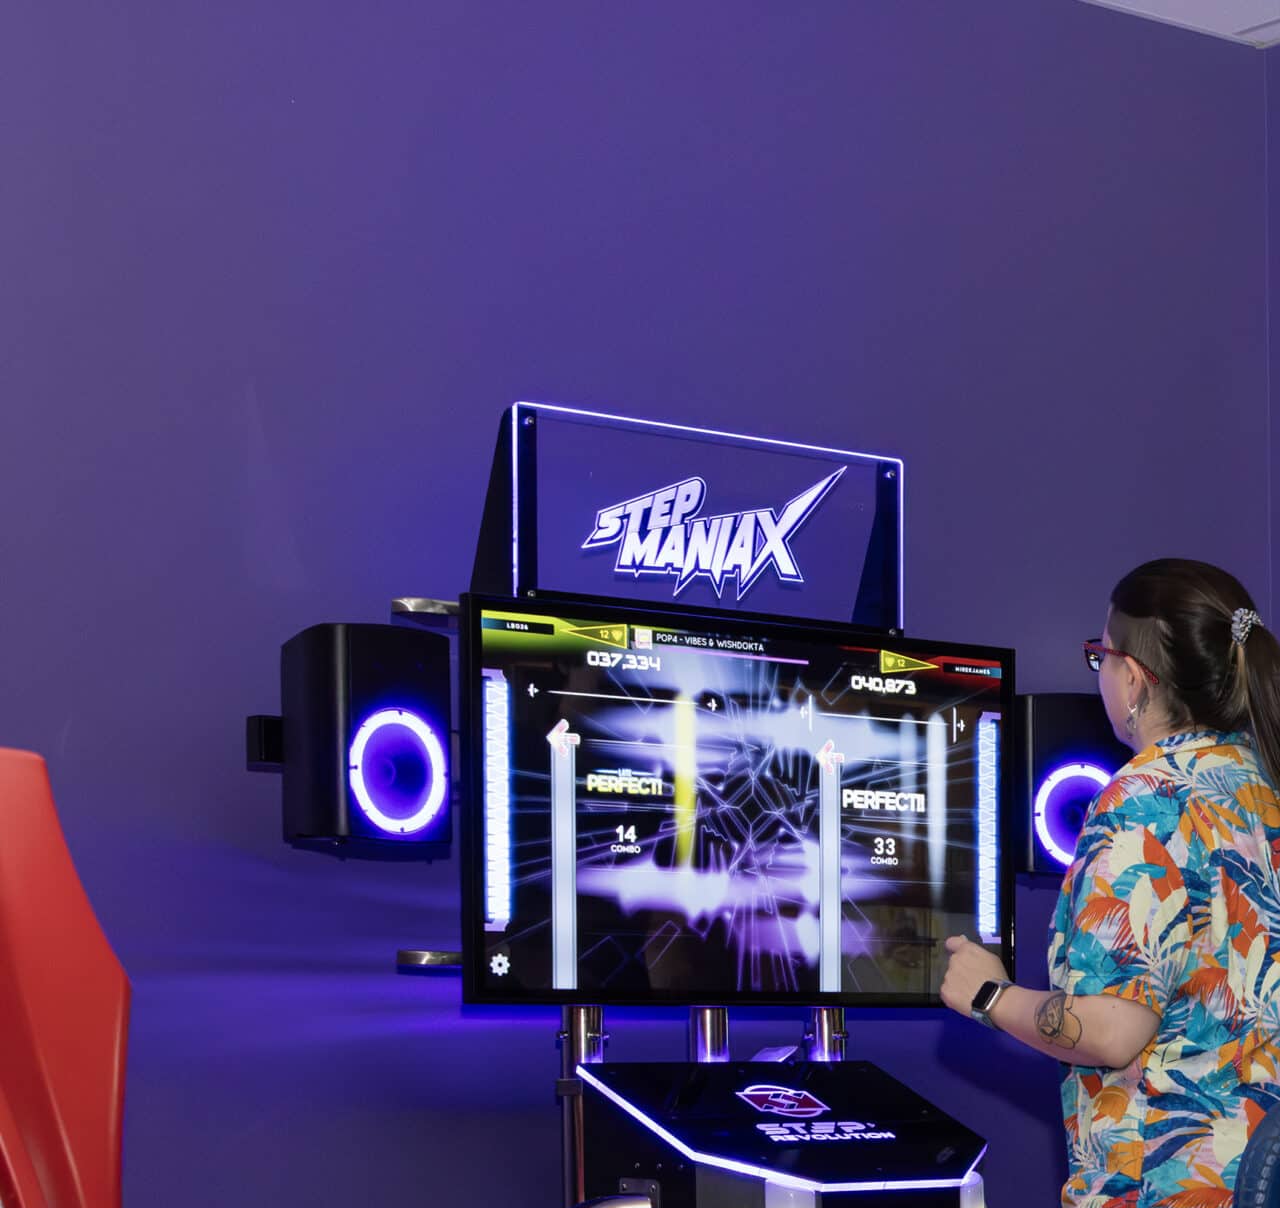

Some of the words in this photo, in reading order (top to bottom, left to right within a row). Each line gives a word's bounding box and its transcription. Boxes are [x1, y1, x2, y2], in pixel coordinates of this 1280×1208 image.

[586, 477, 705, 543] STEP
[616, 466, 846, 596] MANIAX
[656, 633, 678, 643] POP4
[685, 635, 707, 647] VIBES
[716, 639, 765, 652] WISHDOKTA
[587, 650, 661, 671] 037,334
[851, 675, 917, 695] 040,873
[616, 825, 637, 843] 14
[610, 844, 641, 854] COMBO
[873, 837, 896, 856] 33
[870, 856, 899, 866] COMBO
[756, 1121, 868, 1135] STEP
[769, 1131, 896, 1142] REVOLUTION
